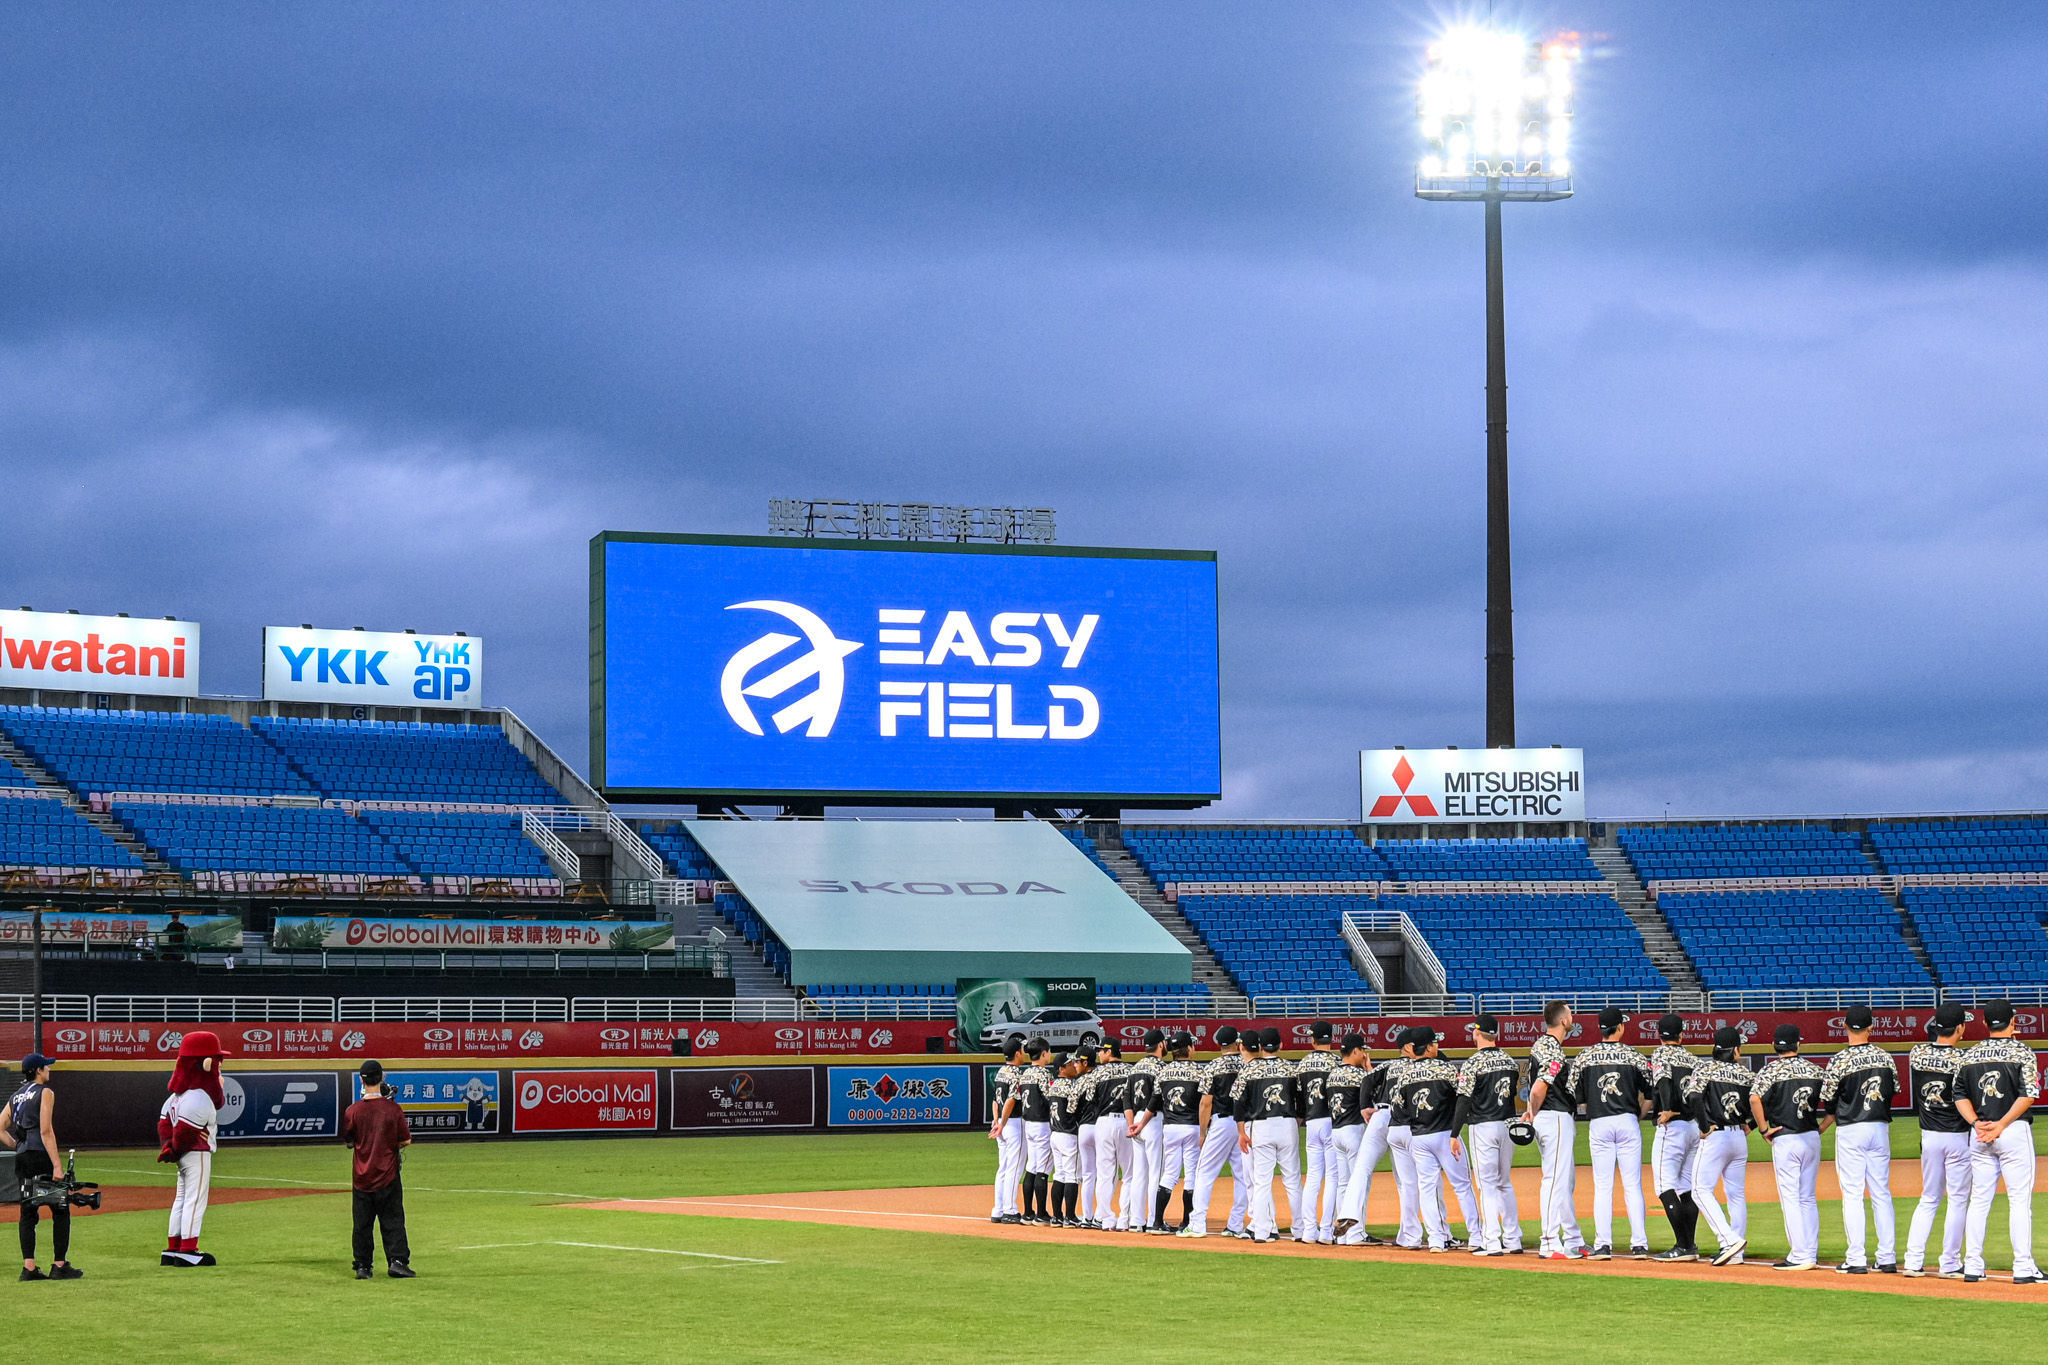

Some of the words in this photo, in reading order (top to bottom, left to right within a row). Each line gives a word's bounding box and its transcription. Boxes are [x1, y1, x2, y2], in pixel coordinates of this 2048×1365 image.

[768, 498, 1057, 544] 樂天桃園棒球場
[879, 609, 1100, 668] EASY
[0, 625, 186, 678] watani
[414, 640, 470, 665] YKK
[279, 645, 390, 686] YKK
[413, 665, 471, 700] ap
[99, 695, 109, 708] H
[353, 707, 365, 720] G
[880, 681, 1100, 740] FIELD
[1444, 771, 1579, 793] MITSUBISHI
[1445, 795, 1562, 817] ELECTRIC
[368, 922, 440, 944] Global
[443, 924, 485, 945] Mall
[488, 925, 601, 945] 環球購物中心
[98, 1029, 150, 1043] 新光人壽
[284, 1029, 334, 1042] 新光人壽
[464, 1028, 513, 1041] 新光人壽
[814, 1028, 862, 1040] 新光人壽
[1332, 1035, 1341, 1043] Shi
[115, 1045, 132, 1054] Kong
[300, 1044, 316, 1053] Kong
[480, 1043, 496, 1052] Kong
[656, 1042, 672, 1051] Kong
[829, 1042, 845, 1050] Kong
[1591, 1053, 1626, 1061] HUANG
[1974, 1049, 2008, 1059] CHUNG
[1921, 1058, 1949, 1068] CHEN
[403, 1084, 455, 1099] 昇通信
[547, 1083, 609, 1104] Global
[613, 1084, 651, 1103] Mall
[848, 1108, 950, 1121] 0800-222-222
[264, 1117, 325, 1131] FOOTER
[406, 1116, 456, 1127] 市場最低價
